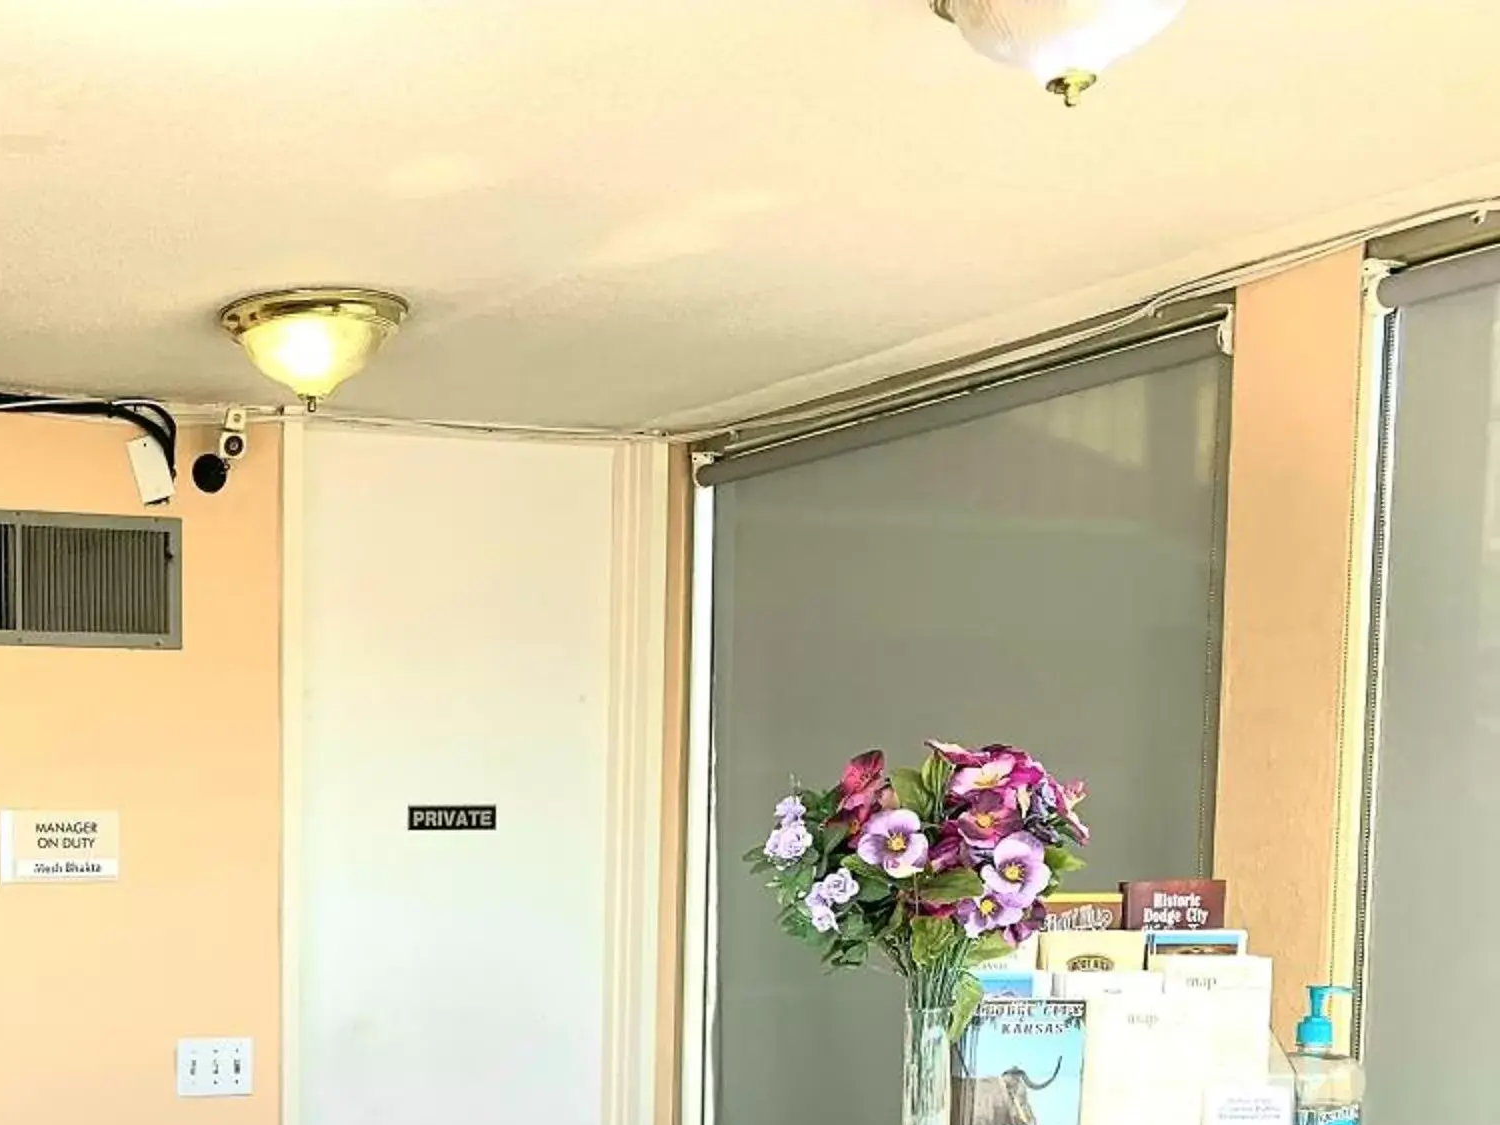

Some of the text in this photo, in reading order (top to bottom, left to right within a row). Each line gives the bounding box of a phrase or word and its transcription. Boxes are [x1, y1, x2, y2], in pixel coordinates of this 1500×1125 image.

[412, 809, 493, 827] PRIVATE
[35, 821, 98, 834] MANAGER
[37, 837, 96, 849] ON DUTY
[1153, 892, 1202, 908] Historic
[1143, 907, 1209, 926] Dodge City
[1001, 1023, 1065, 1035] KANSAS
